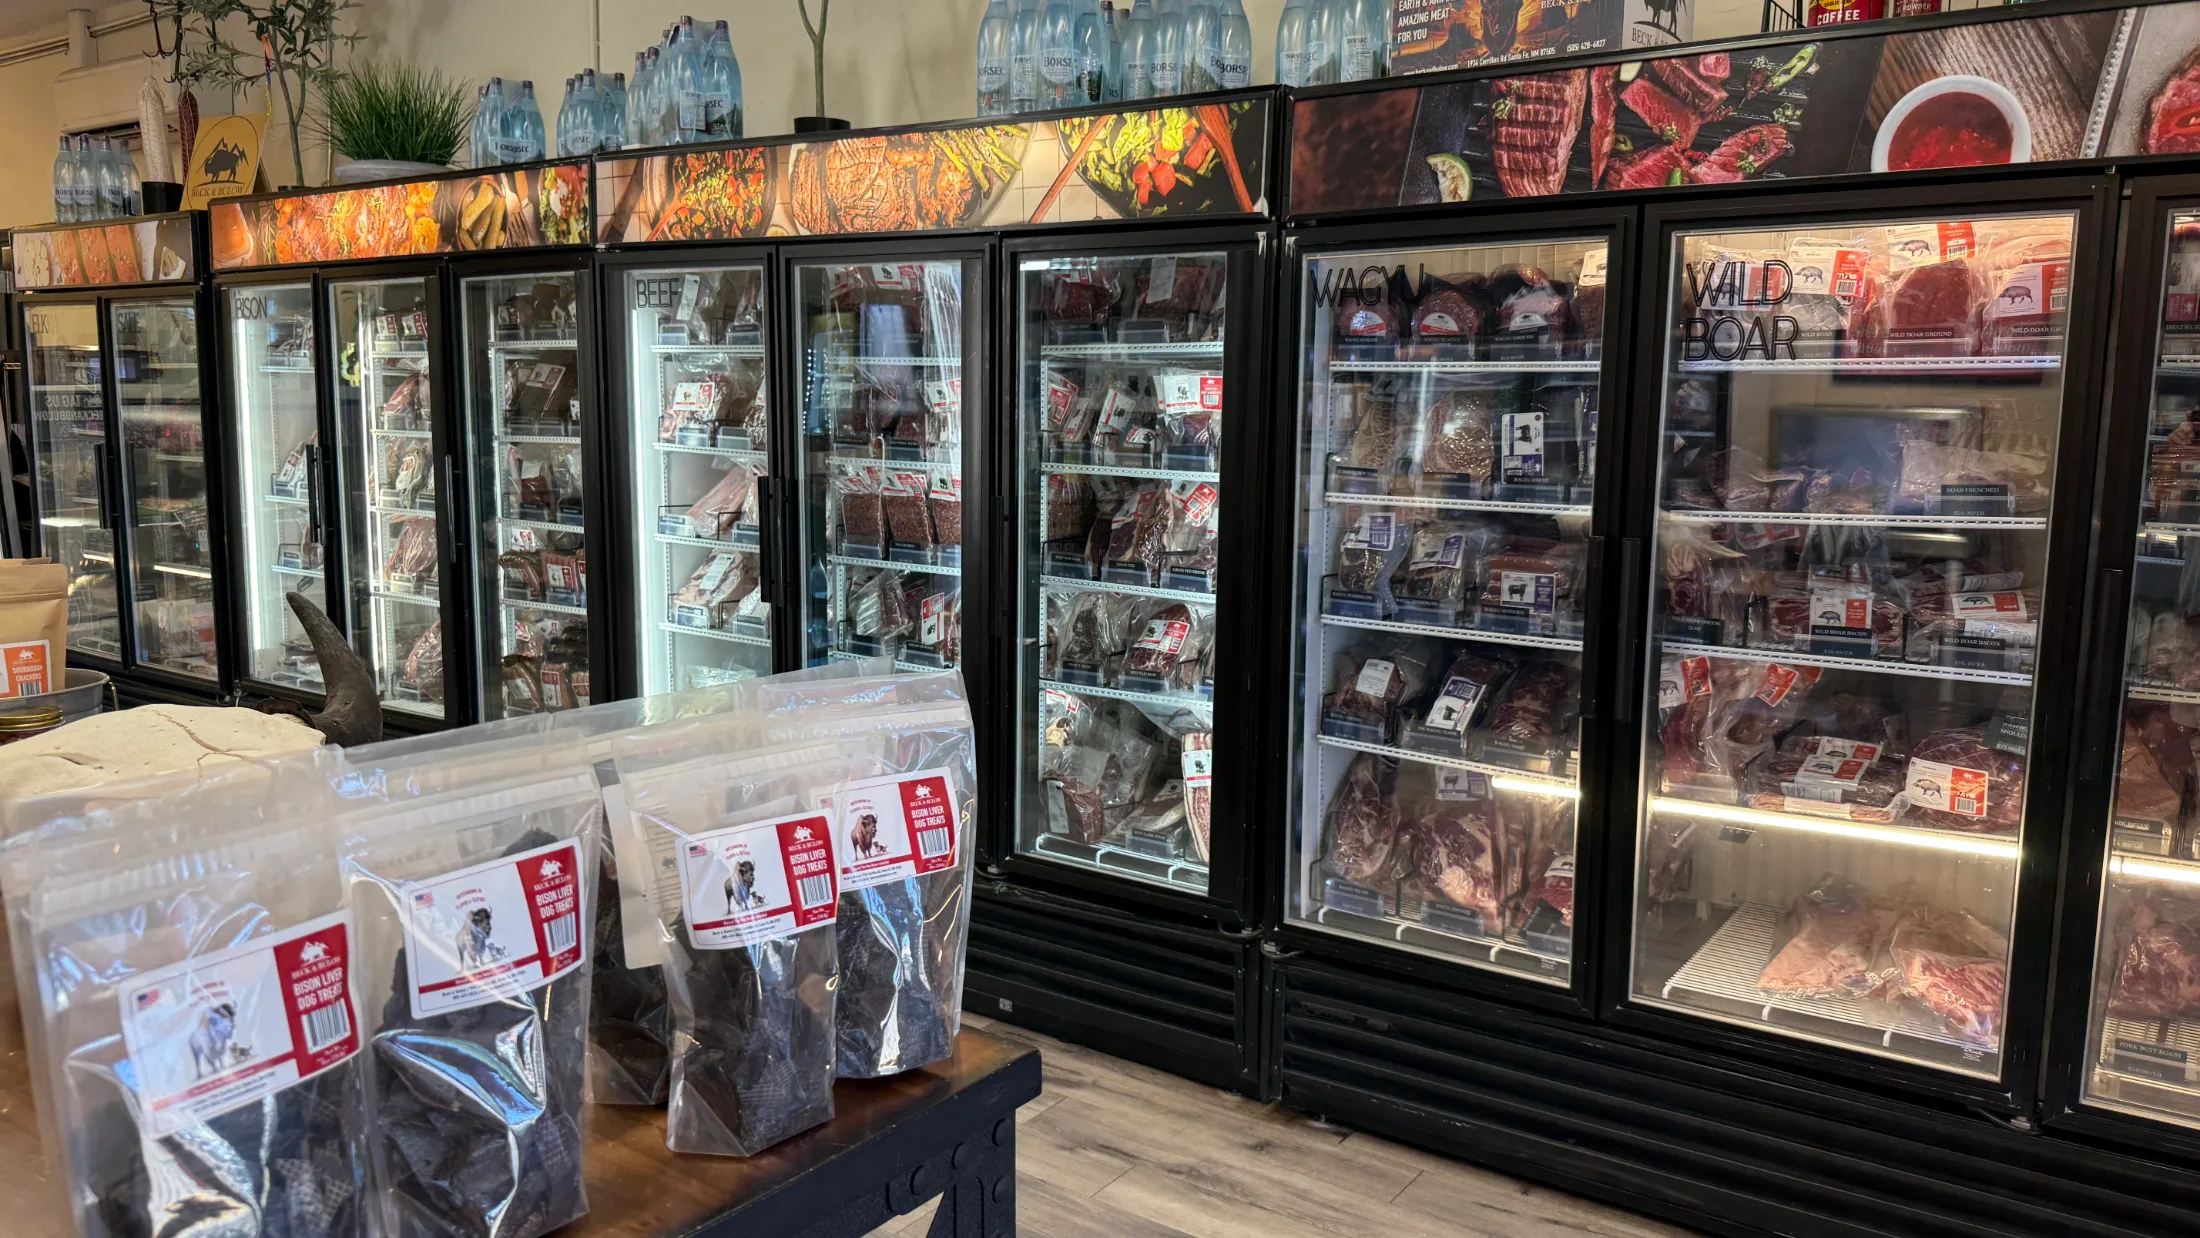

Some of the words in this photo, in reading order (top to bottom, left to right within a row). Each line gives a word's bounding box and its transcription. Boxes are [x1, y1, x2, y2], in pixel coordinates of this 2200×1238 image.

[1398, 13, 1429, 28] AMAZING
[1430, 8, 1450, 22] MEAT
[1816, 10, 1860, 26] COFFEE
[1398, 32, 1412, 44] FOR
[1413, 28, 1428, 40] YOU
[1632, 28, 1652, 46] BECK
[1508, 52, 1521, 61] Santa
[192, 187, 210, 198] BECK
[210, 188, 217, 196] &
[1310, 263, 1424, 308] WAGYU
[1686, 260, 1793, 307] WILD
[636, 278, 679, 308] BEEF
[236, 297, 267, 320] BISON
[1684, 316, 1799, 361] BOAR
[16, 673, 42, 682] CRACKERS
[912, 808, 928, 818] BISON
[929, 806, 944, 815] LIVER
[914, 818, 926, 828] DOG
[927, 815, 946, 826] TREATS
[789, 852, 809, 865] BISON
[810, 849, 827, 860] LIVER
[793, 864, 807, 876] DOG
[807, 860, 828, 872] TREATS
[535, 890, 557, 906] BISON
[557, 884, 574, 899] LIVER
[540, 903, 555, 918] DOG
[556, 898, 574, 914] TREATS
[293, 975, 322, 997] BISON
[322, 967, 343, 985] LIVER
[298, 991, 318, 1011] DOG
[318, 983, 343, 1004] TREATS
[2140, 1046, 2158, 1054] BUTT
[2159, 1049, 2182, 1058] ROAST
